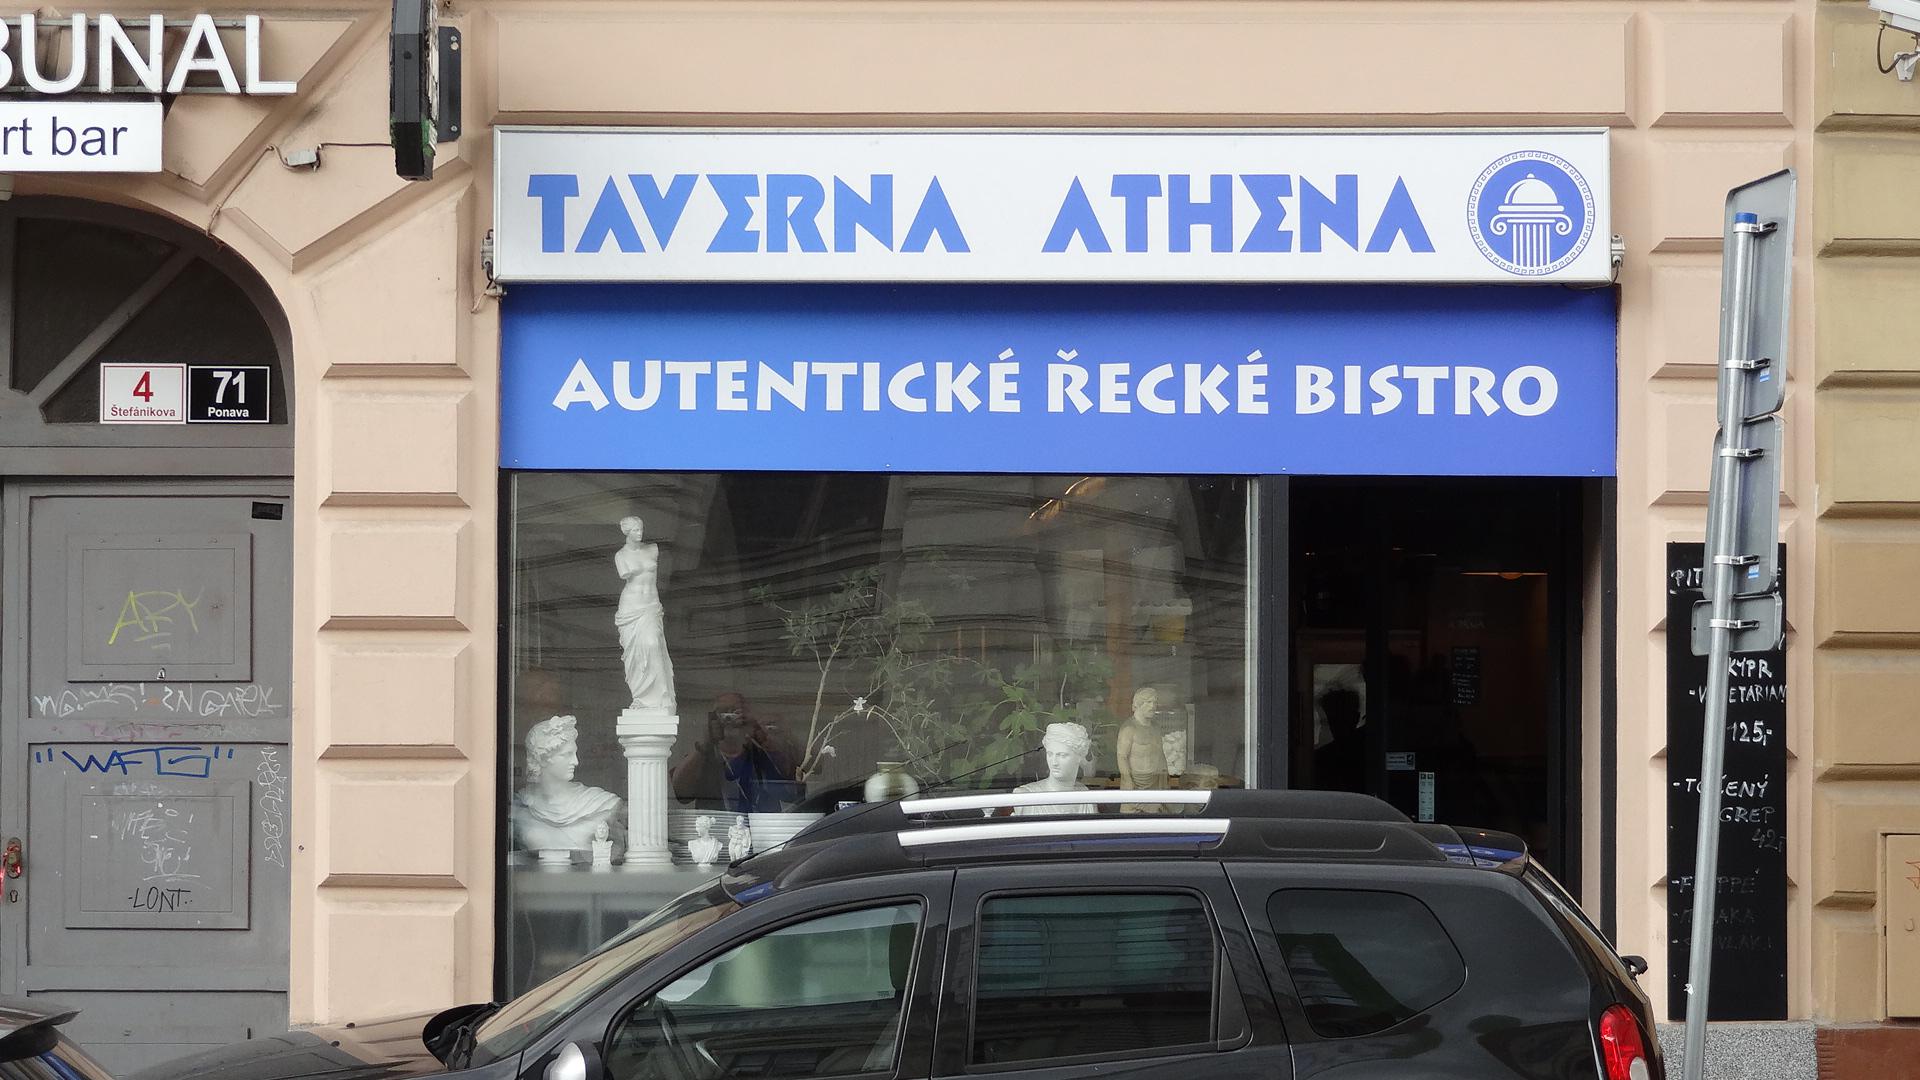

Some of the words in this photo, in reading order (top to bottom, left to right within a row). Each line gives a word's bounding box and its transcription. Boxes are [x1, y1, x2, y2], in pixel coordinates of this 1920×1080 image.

[0, 13, 298, 95] UNAL
[51, 115, 129, 157] bar
[132, 370, 154, 403] 4
[212, 370, 246, 404] 71
[552, 347, 1021, 413] AUTENTICKÉ
[1047, 347, 1270, 415] ŘECKÉ
[1295, 364, 1559, 417] BISTRO
[110, 404, 176, 418] Štefánikova
[207, 406, 250, 418] Ponava
[1671, 567, 1704, 587] PIT
[1718, 806, 1777, 824] GREP
